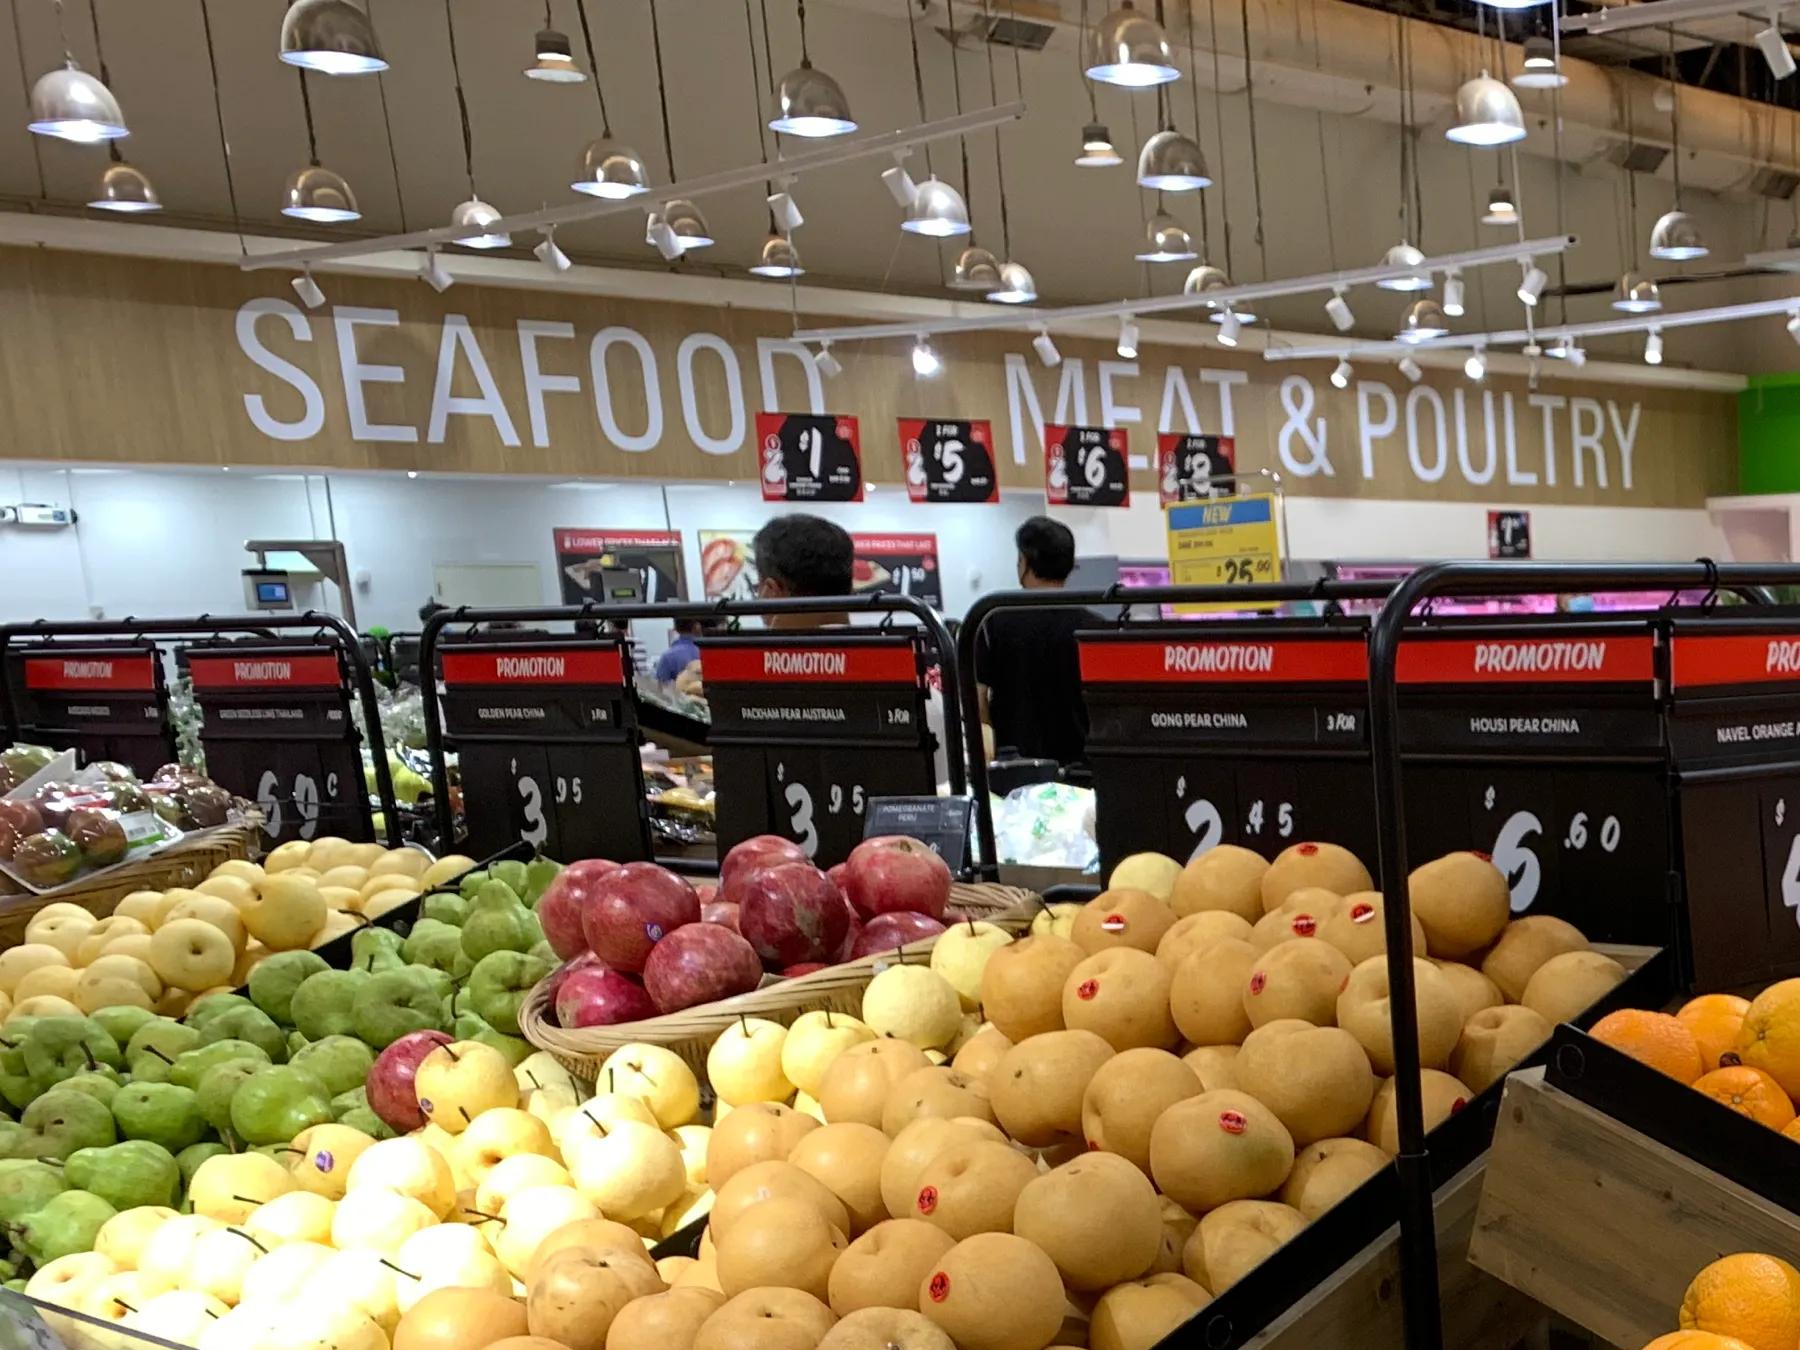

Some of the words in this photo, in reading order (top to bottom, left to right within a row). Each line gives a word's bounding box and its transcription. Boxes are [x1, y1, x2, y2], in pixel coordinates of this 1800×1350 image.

[235, 298, 825, 455] SEAFOOD
[1278, 375, 1336, 478] &
[1358, 380, 1642, 490] POULTRY
[496, 657, 564, 678] PROMOTION
[764, 651, 846, 675] PROMOTION
[1164, 645, 1274, 672] PROMOTION
[1474, 642, 1606, 673] PROMOTION
[234, 661, 291, 680] PROMOTION
[478, 708, 505, 719] GOLDEN
[802, 708, 846, 721] AUSTRALIA
[1151, 712, 1183, 727] GONG
[1184, 713, 1212, 728] PEAR
[1213, 713, 1248, 728] CHINA
[1327, 715, 1334, 730] 3
[1335, 715, 1356, 731] FOR
[1470, 717, 1508, 733] HOUSI
[1509, 718, 1540, 733] PEAR
[1541, 719, 1580, 734] CHINA
[1717, 725, 1751, 744] NAVEL
[1752, 721, 1795, 741] ORANGE
[1484, 784, 1496, 811] $
[1774, 797, 1786, 827] $
